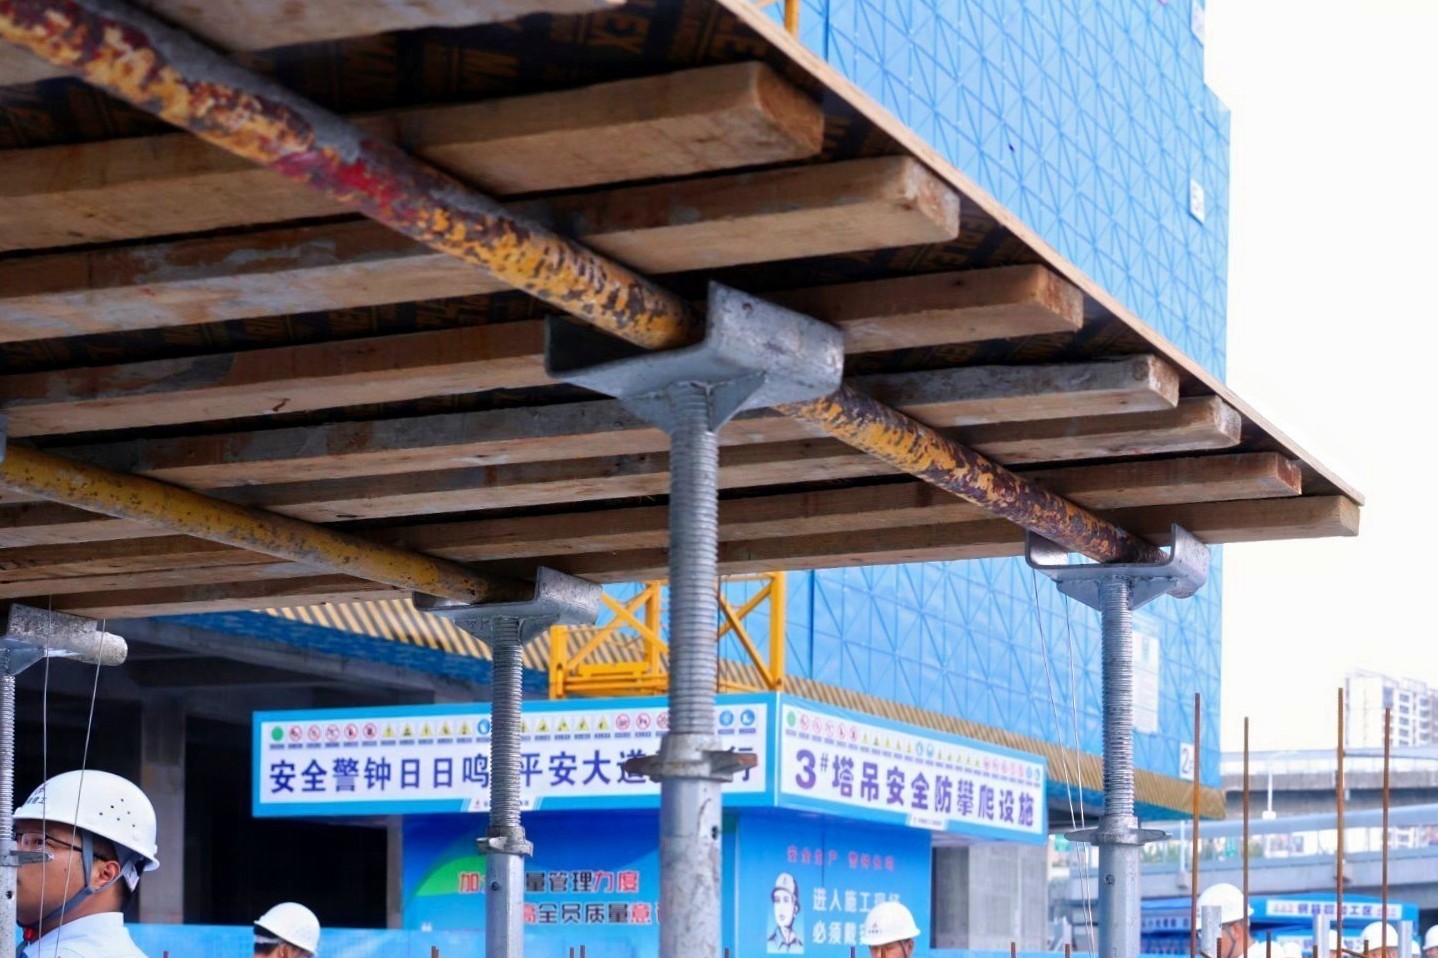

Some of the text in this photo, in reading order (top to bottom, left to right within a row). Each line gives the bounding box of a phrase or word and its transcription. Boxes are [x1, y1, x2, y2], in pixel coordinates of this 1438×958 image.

[269, 753, 490, 793] 安全警钟日日鸣
